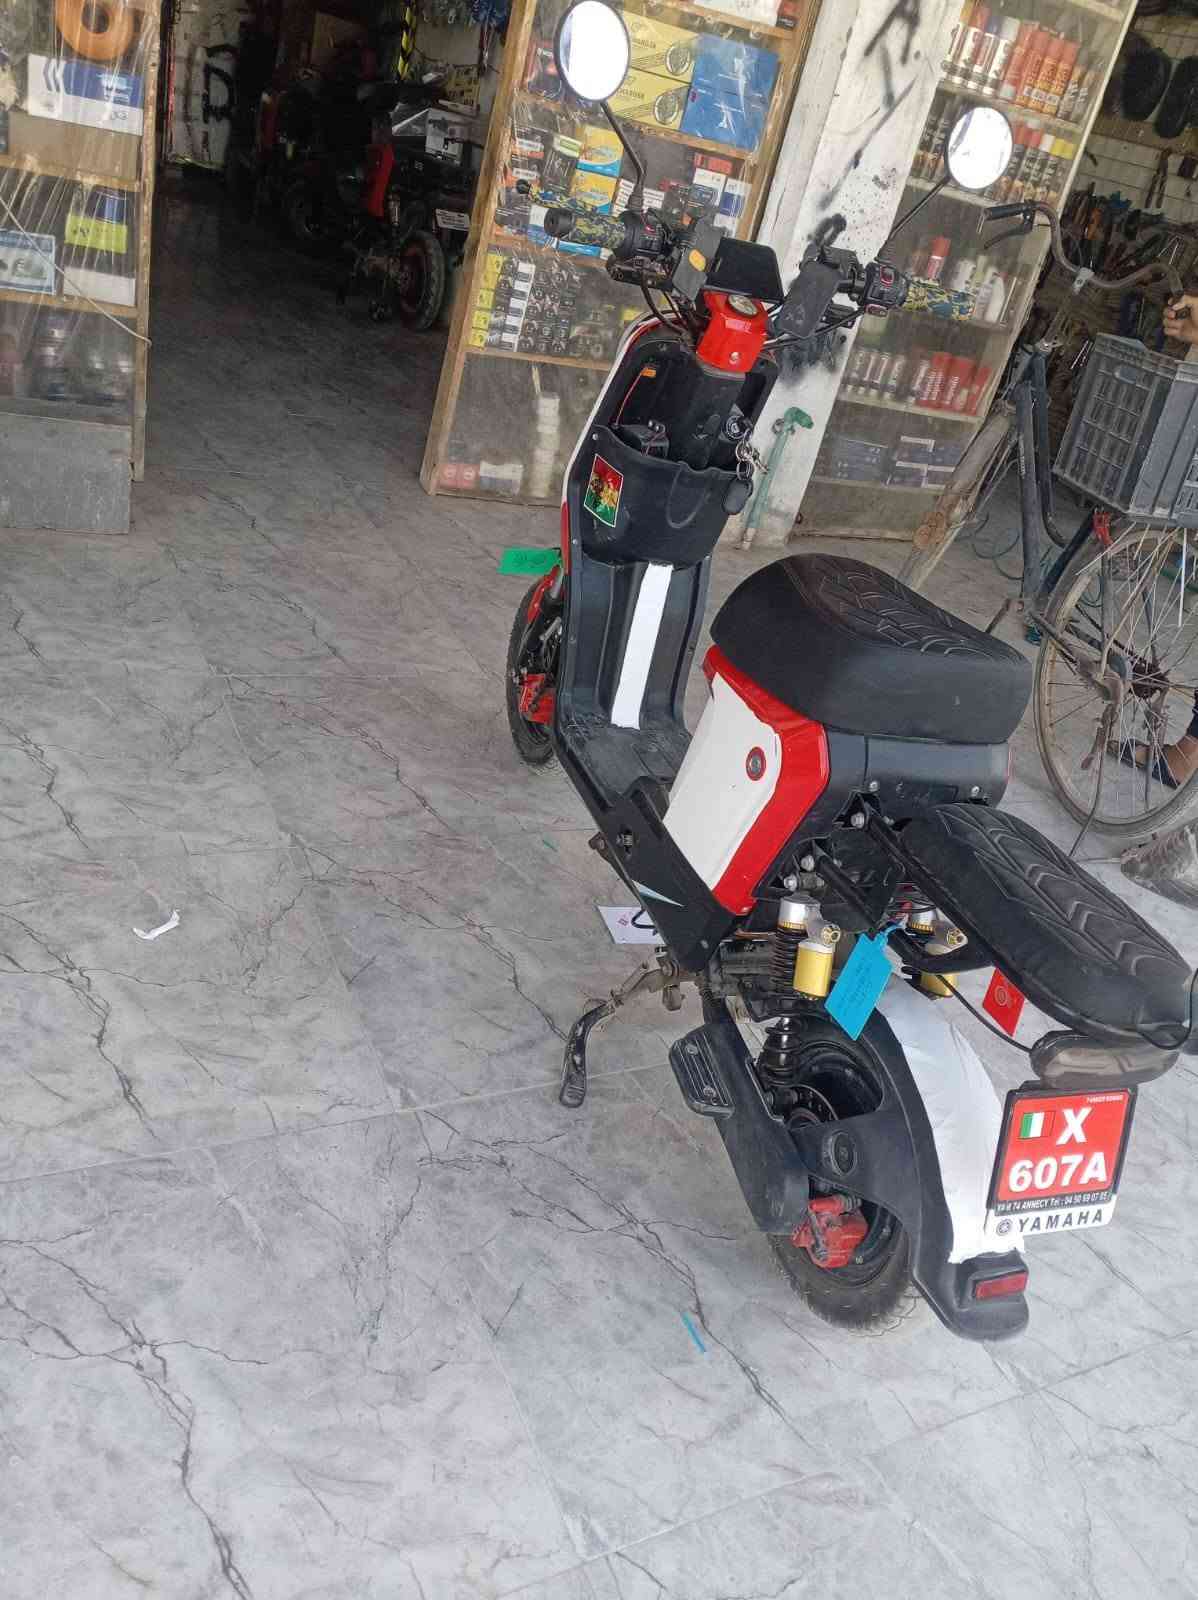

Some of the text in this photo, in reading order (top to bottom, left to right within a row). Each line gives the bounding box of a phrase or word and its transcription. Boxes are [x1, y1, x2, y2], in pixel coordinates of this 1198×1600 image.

[1055, 1106, 1092, 1146] X
[1008, 1151, 1108, 1193] 607A
[1021, 1197, 1049, 1210] ANNECY
[1019, 1208, 1103, 1233] YAMAHA
